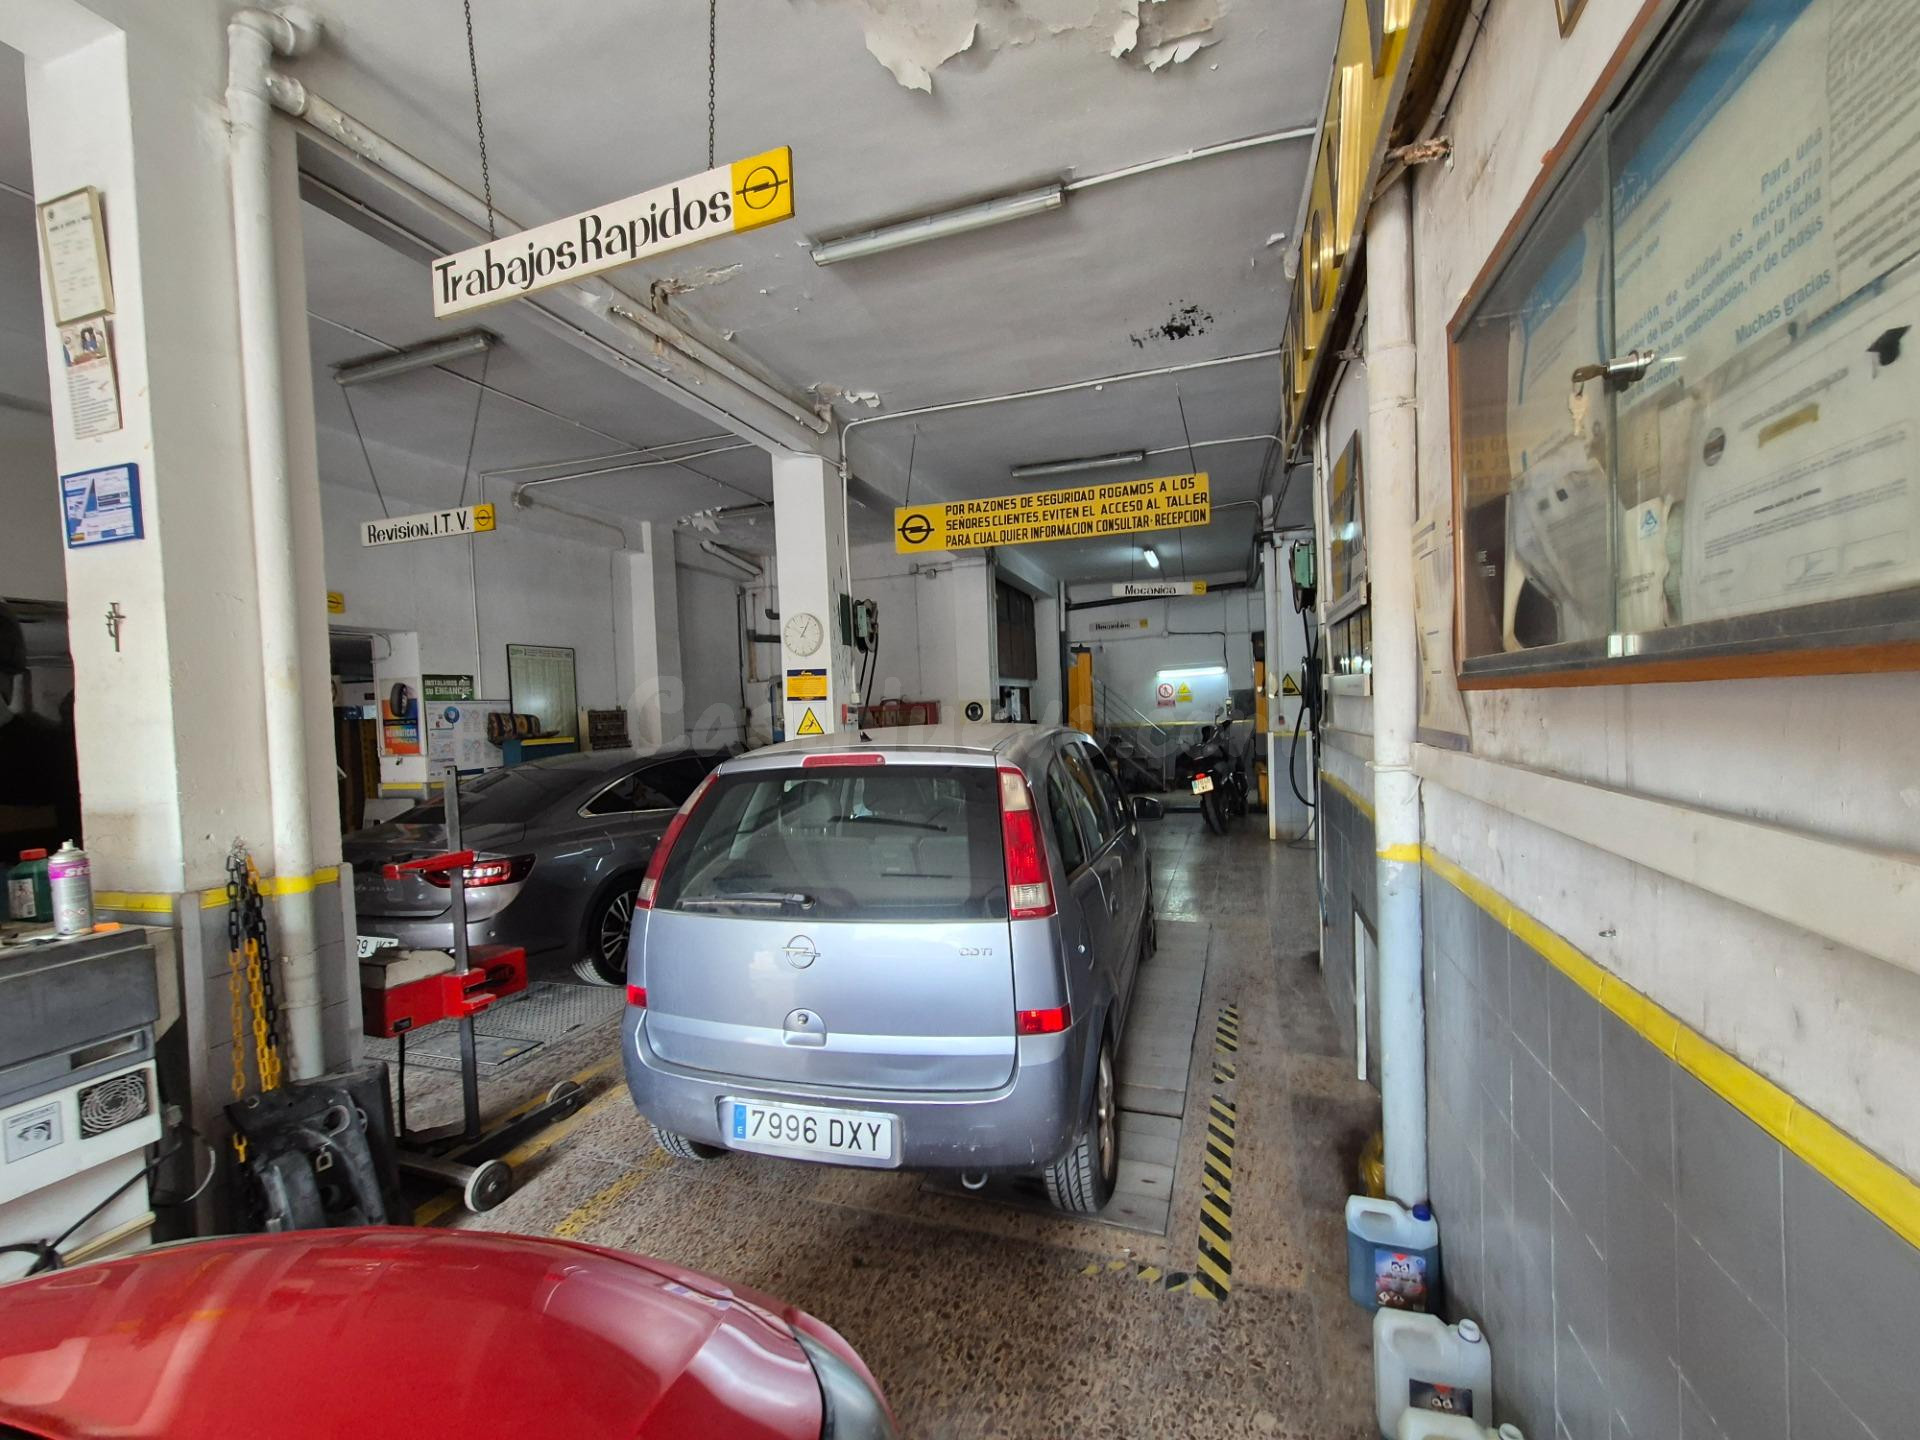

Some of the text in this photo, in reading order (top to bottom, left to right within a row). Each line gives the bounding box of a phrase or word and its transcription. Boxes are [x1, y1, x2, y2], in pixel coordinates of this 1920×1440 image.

[435, 187, 733, 305] Trabajos Rapidos
[1733, 267, 1833, 347] Muchas gracias
[945, 477, 1196, 517] POR RAZONES DE SEGURIDAD ROGAMOS A LOS
[945, 512, 991, 532] SEÑORES
[1042, 506, 1080, 524] EVITEN
[1082, 504, 1095, 518] EL
[1101, 499, 1144, 517] ACCESO
[1146, 496, 1161, 510] AL
[1165, 490, 1208, 509] TALLER
[945, 532, 972, 548] PARA
[973, 525, 1029, 546] CUALQUIER
[1030, 518, 1094, 540] INFORMACION
[751, 1110, 818, 1145] 7996
[829, 1120, 882, 1153] DXY
